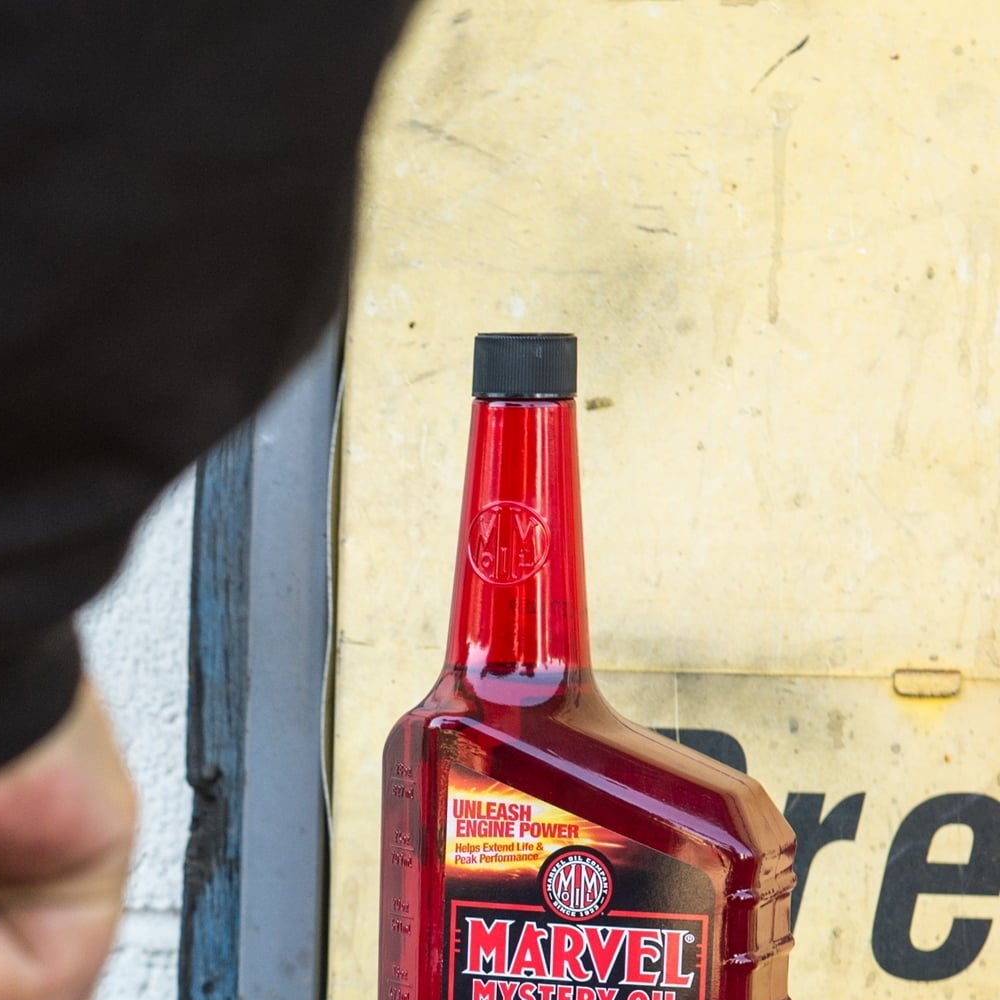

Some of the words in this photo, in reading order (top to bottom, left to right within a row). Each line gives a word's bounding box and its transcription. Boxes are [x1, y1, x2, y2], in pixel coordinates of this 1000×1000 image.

[453, 799, 532, 822] UNLEASH
[456, 819, 515, 837] ENGINE
[519, 822, 579, 838] POWER
[455, 843, 480, 854] Helps
[483, 842, 514, 853] Extend
[517, 842, 534, 852] Life
[536, 842, 544, 851] &
[650, 728, 1000, 982] re
[455, 854, 477, 864] Peak
[479, 853, 539, 863] Performance
[547, 859, 566, 891] MARVEL
[586, 858, 608, 895] COMPANY
[553, 900, 576, 917] SINCE
